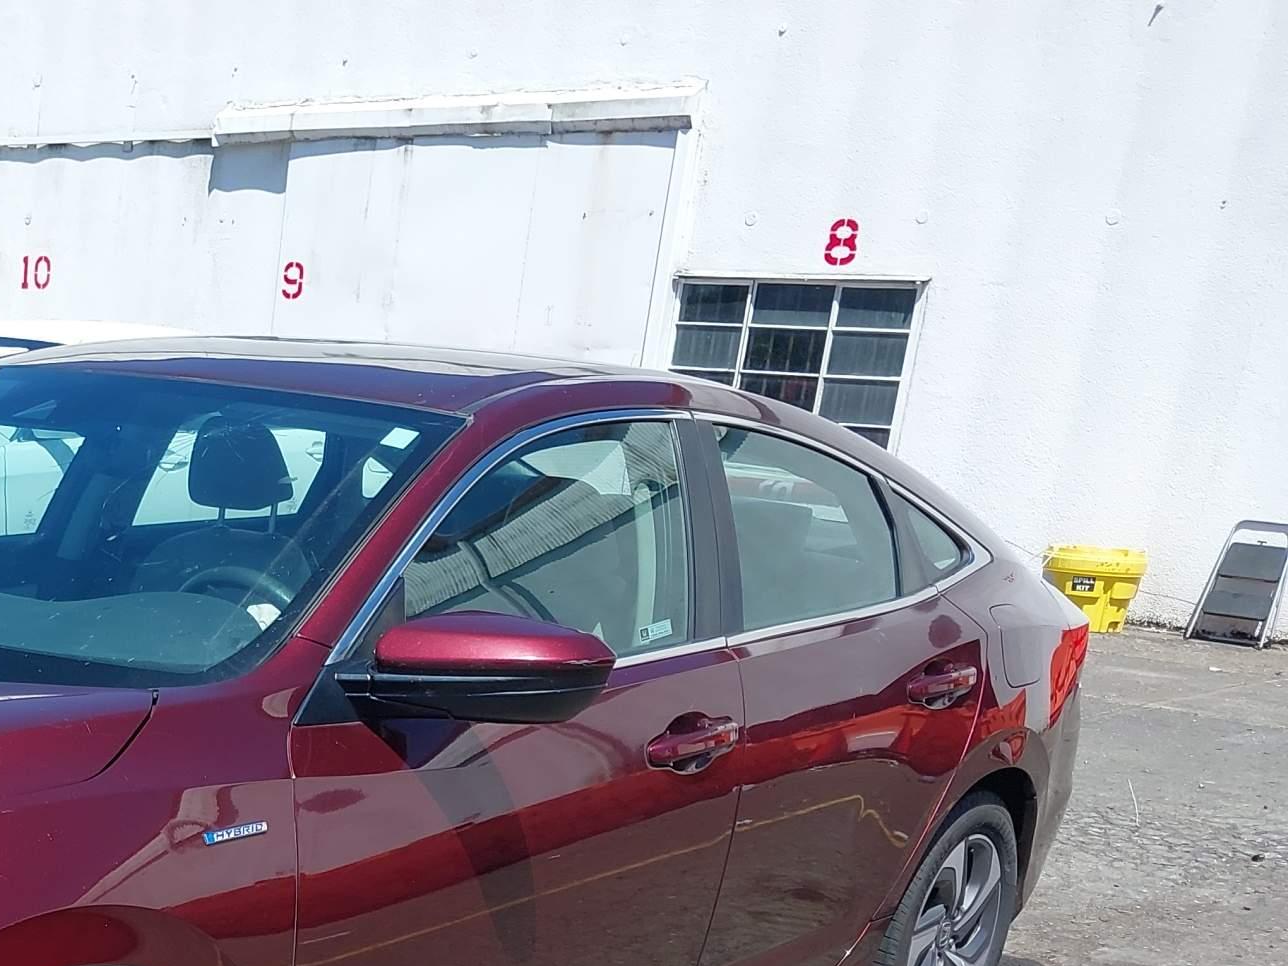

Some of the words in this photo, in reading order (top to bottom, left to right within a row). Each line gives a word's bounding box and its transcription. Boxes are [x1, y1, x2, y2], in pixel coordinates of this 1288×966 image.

[824, 218, 859, 266] 8
[21, 255, 51, 289] 10
[281, 261, 304, 299] 9
[216, 823, 263, 839] HYBRID
